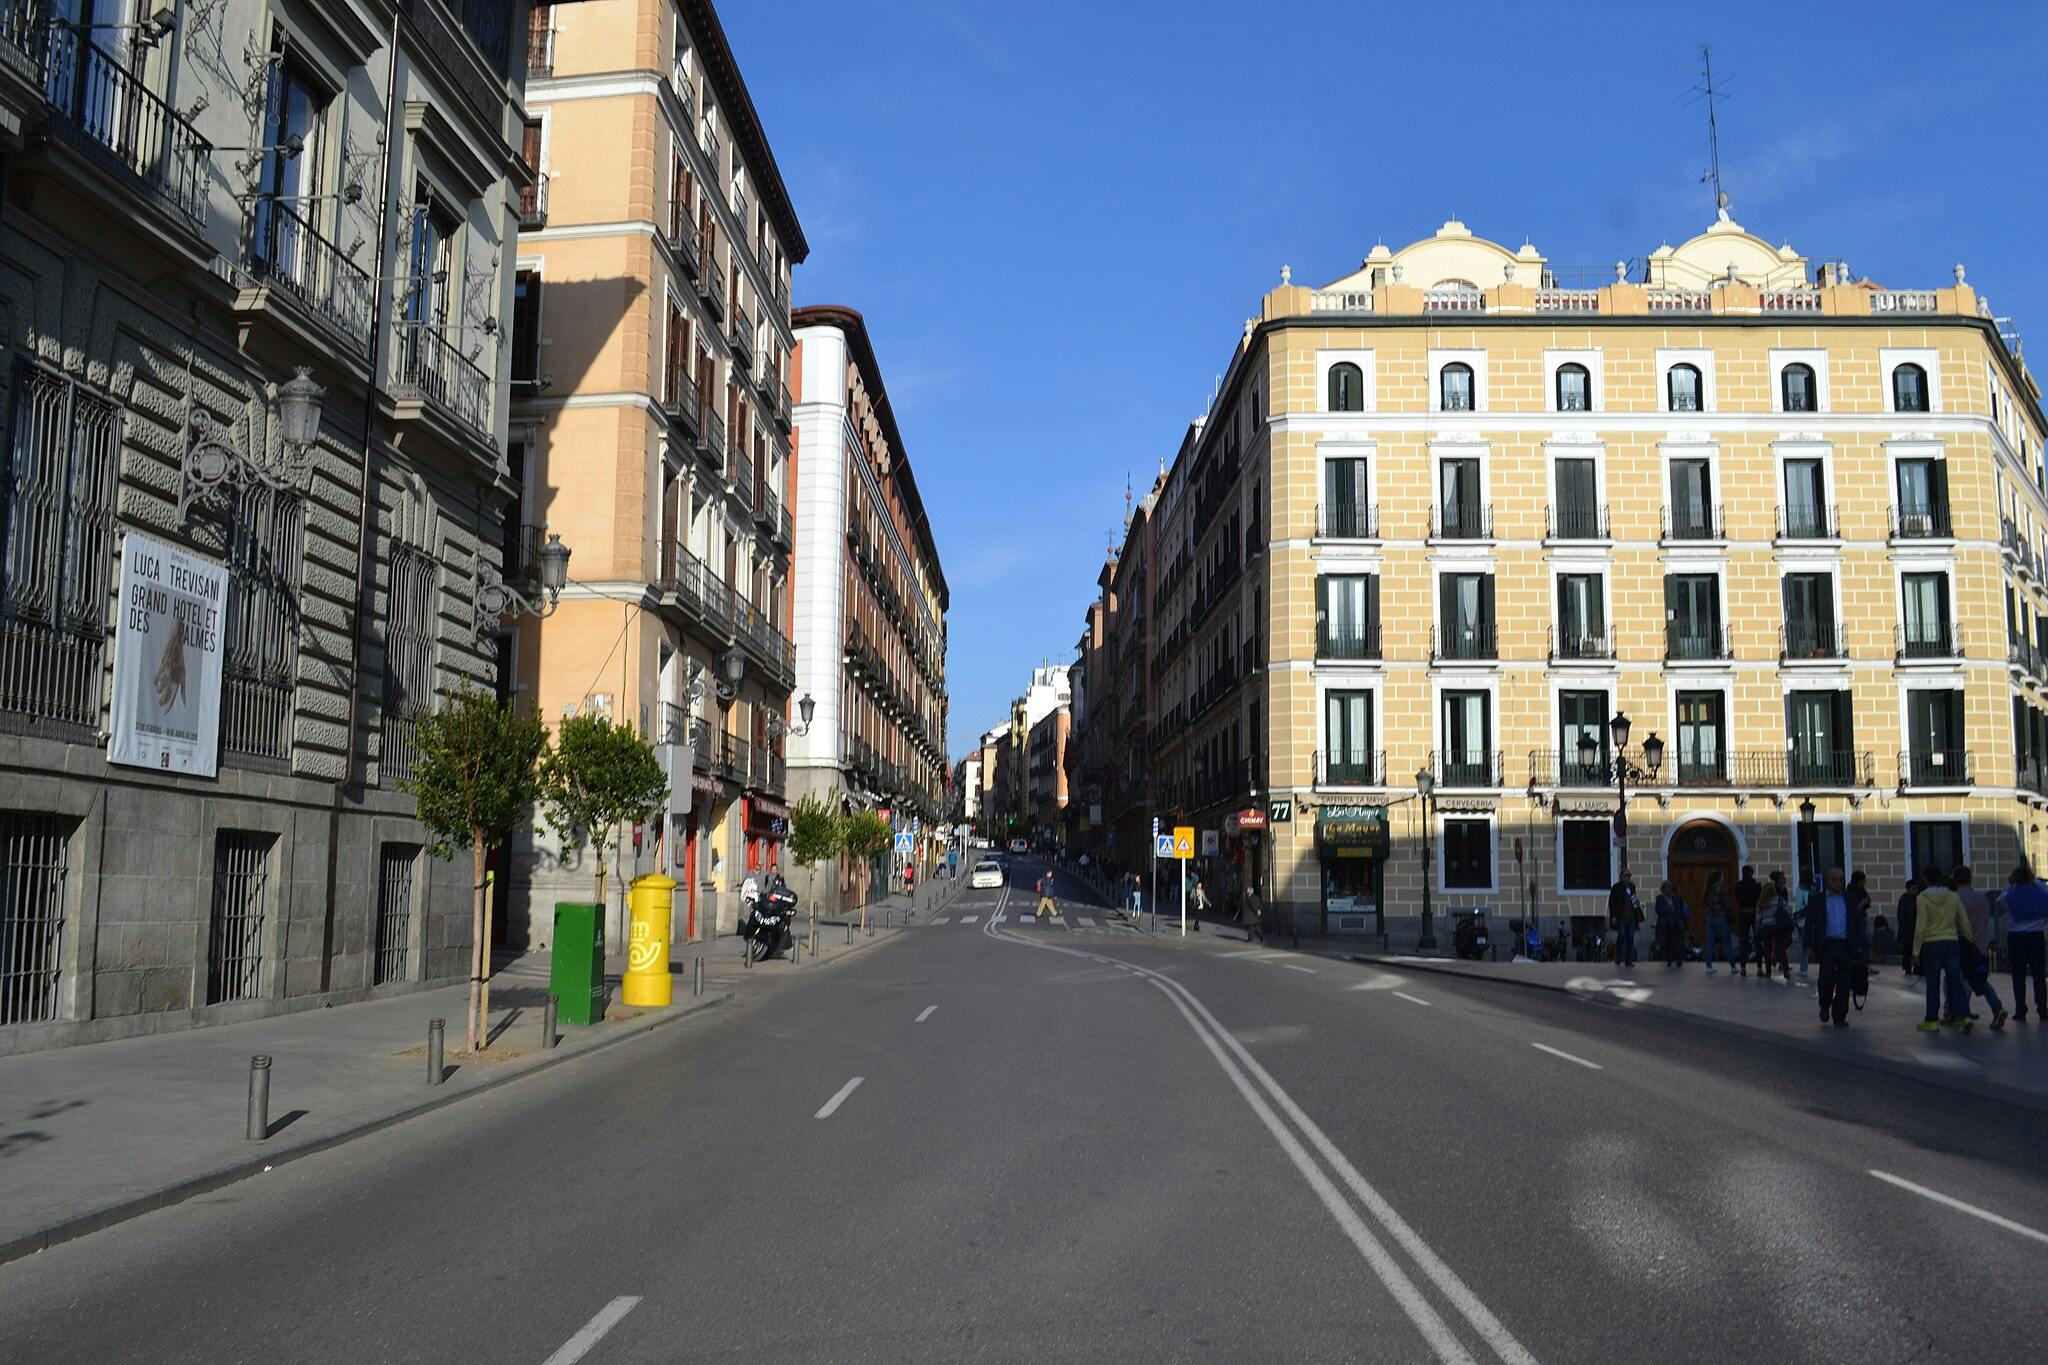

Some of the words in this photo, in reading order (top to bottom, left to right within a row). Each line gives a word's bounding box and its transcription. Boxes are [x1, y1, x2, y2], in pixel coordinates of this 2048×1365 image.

[134, 552, 160, 581] LUCA
[170, 565, 220, 601] TREVISANI
[129, 607, 150, 633] DES
[179, 622, 216, 652] PALMES
[131, 584, 167, 614] GRAND
[173, 597, 202, 626] HOTEL
[206, 608, 217, 630] ET
[1272, 803, 1290, 819] 77
